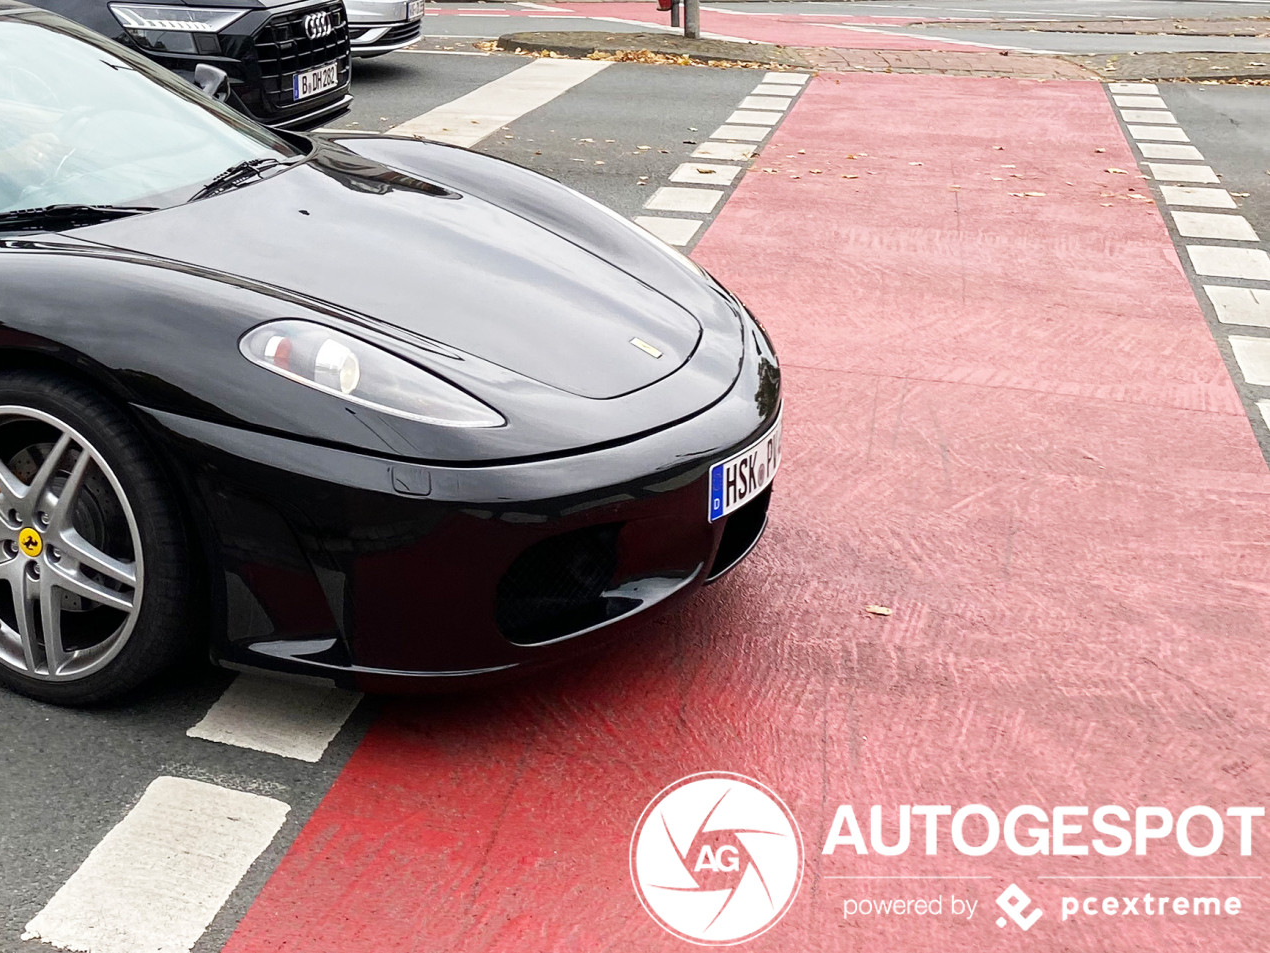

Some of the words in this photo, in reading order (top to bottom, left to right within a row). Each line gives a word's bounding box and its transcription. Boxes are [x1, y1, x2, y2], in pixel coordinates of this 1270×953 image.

[302, 75, 308, 95] B
[312, 71, 323, 91] DH
[726, 451, 758, 508] HSK
[713, 498, 720, 510] D
